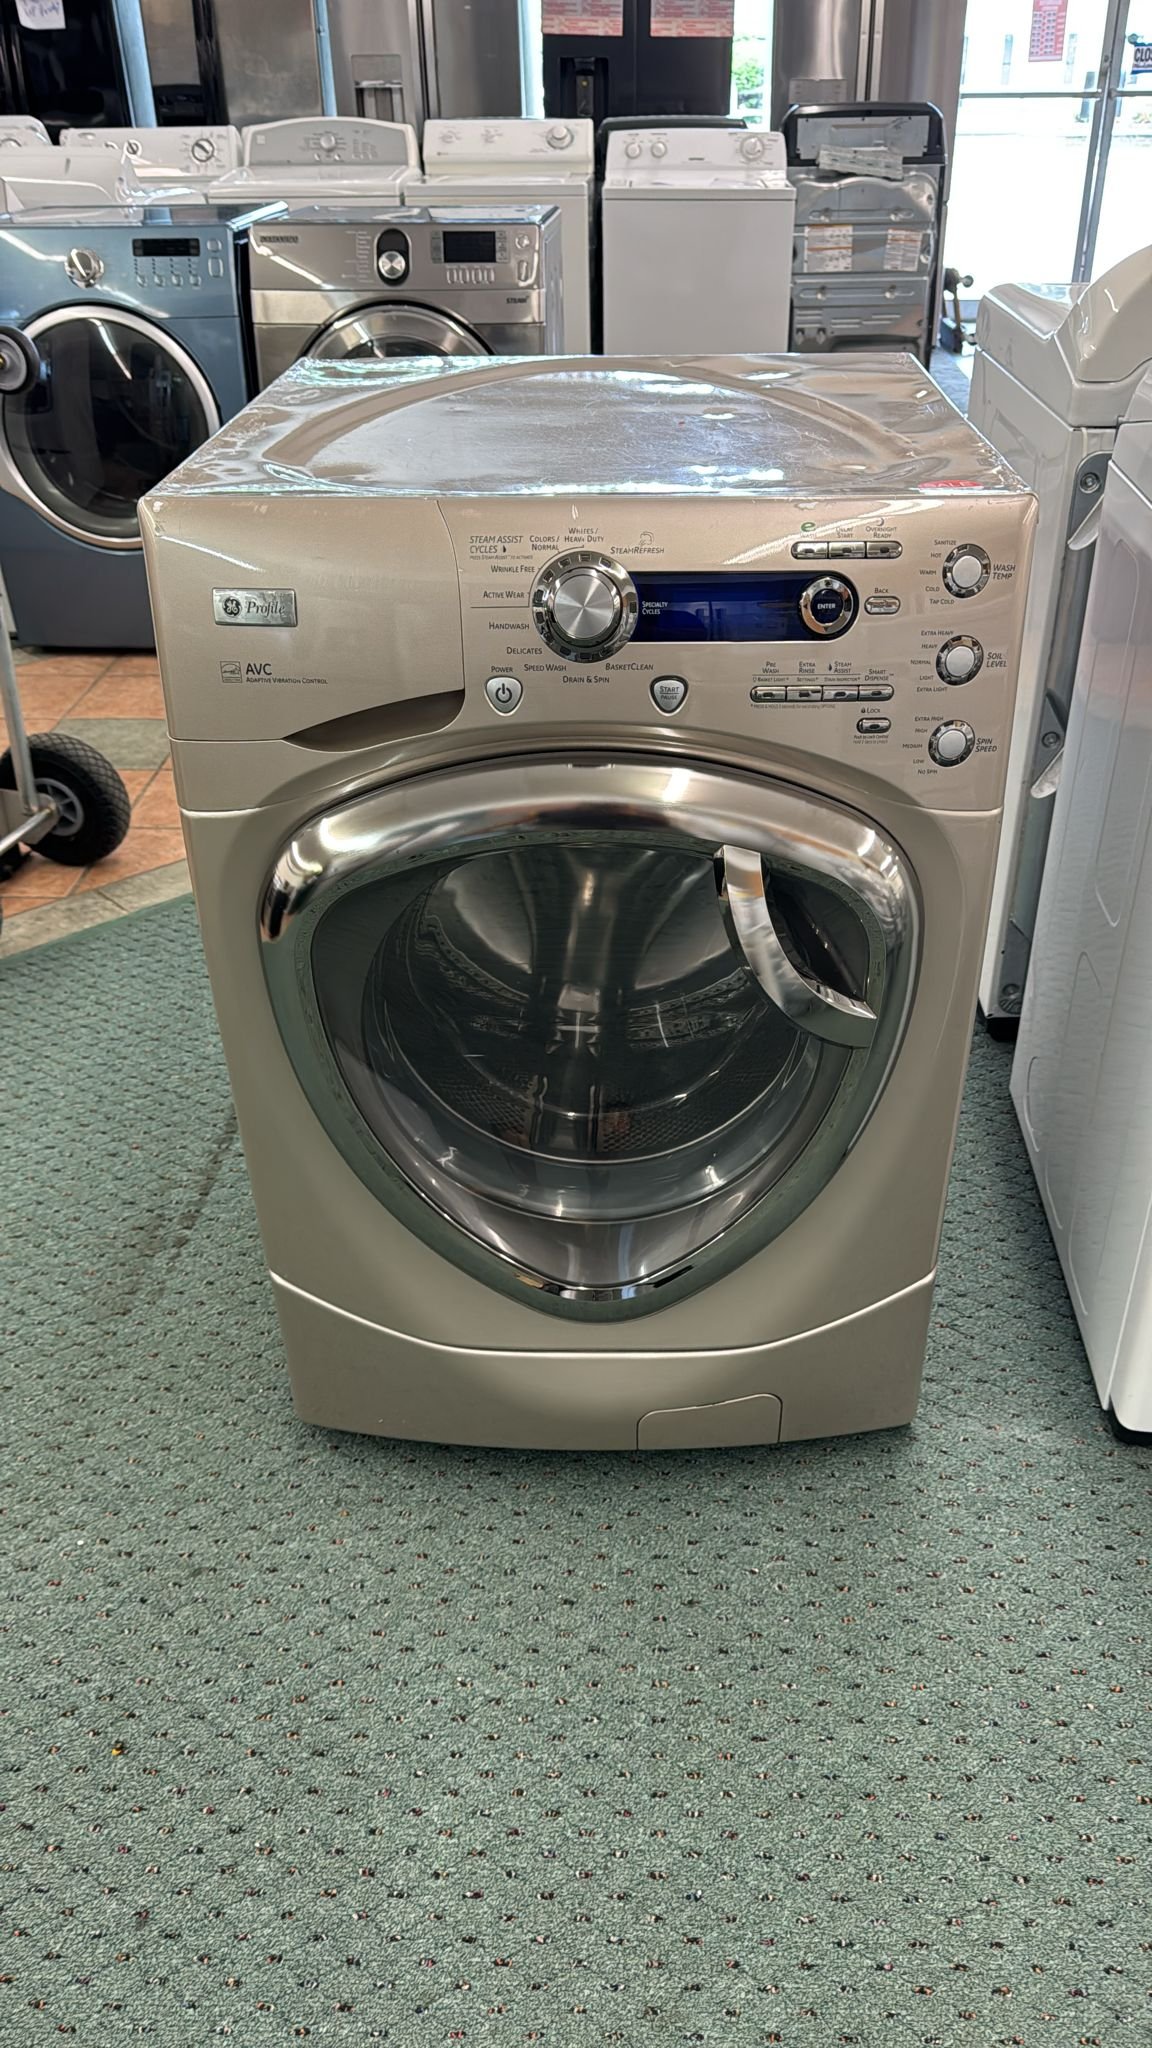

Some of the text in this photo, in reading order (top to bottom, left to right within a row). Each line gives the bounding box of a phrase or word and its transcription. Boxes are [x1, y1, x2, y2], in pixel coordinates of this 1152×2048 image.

[1134, 48, 1152, 62] CLO
[470, 545, 498, 553] CYCLES
[491, 565, 536, 573] WRINKLE FREE
[993, 564, 1016, 572] WASH
[246, 600, 285, 616] Profile
[488, 622, 530, 630] HANDWASH
[986, 660, 1008, 668] LEVEL
[246, 663, 272, 675] AVC
[976, 737, 992, 745] SPIN
